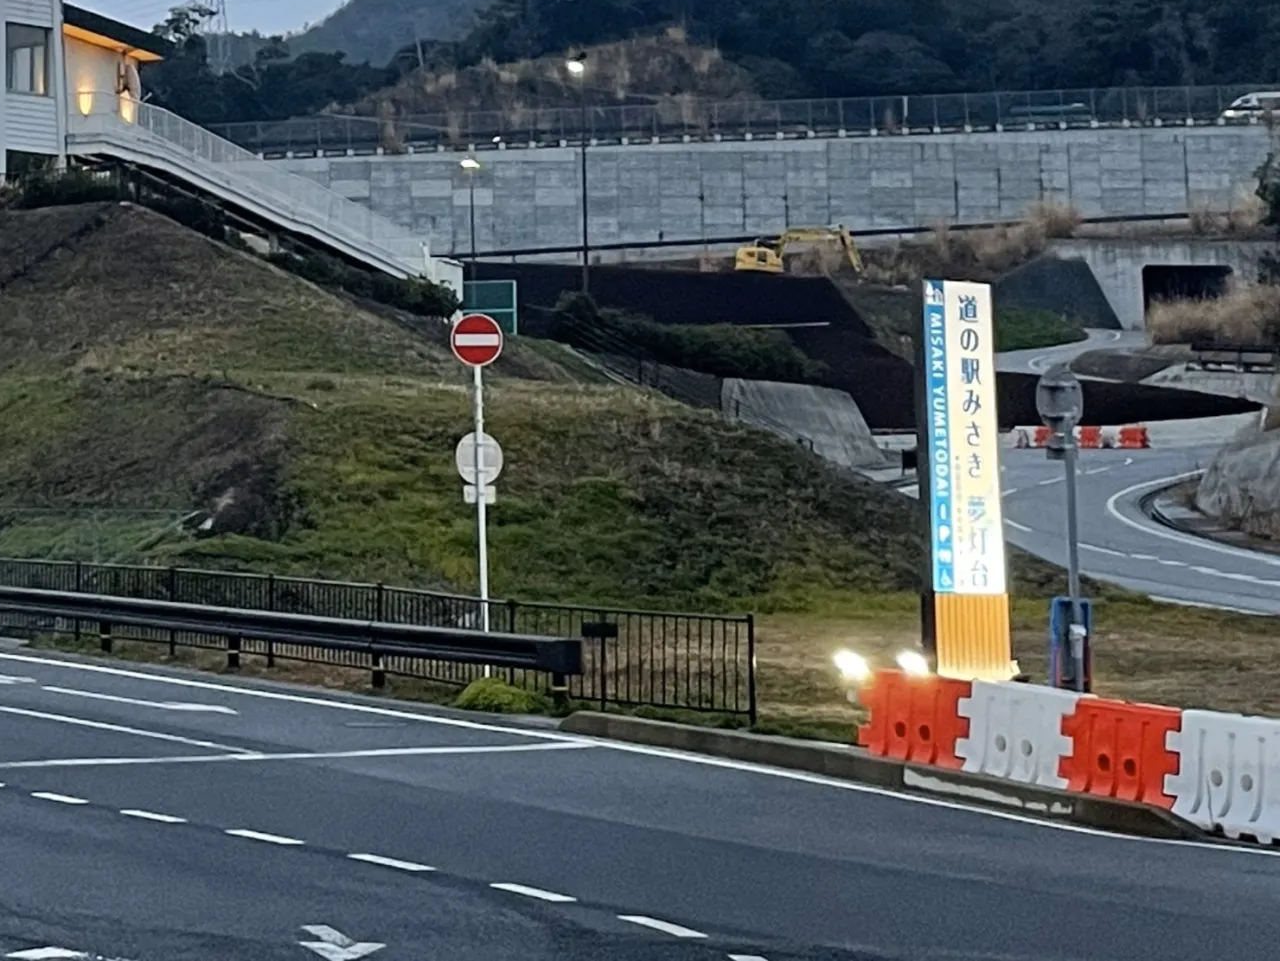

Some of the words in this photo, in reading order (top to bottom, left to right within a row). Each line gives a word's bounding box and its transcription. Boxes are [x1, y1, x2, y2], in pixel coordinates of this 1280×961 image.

[929, 312, 945, 378] MISAKI
[957, 294, 983, 479] 道の駅みさき
[932, 385, 950, 498] YUMETODAI
